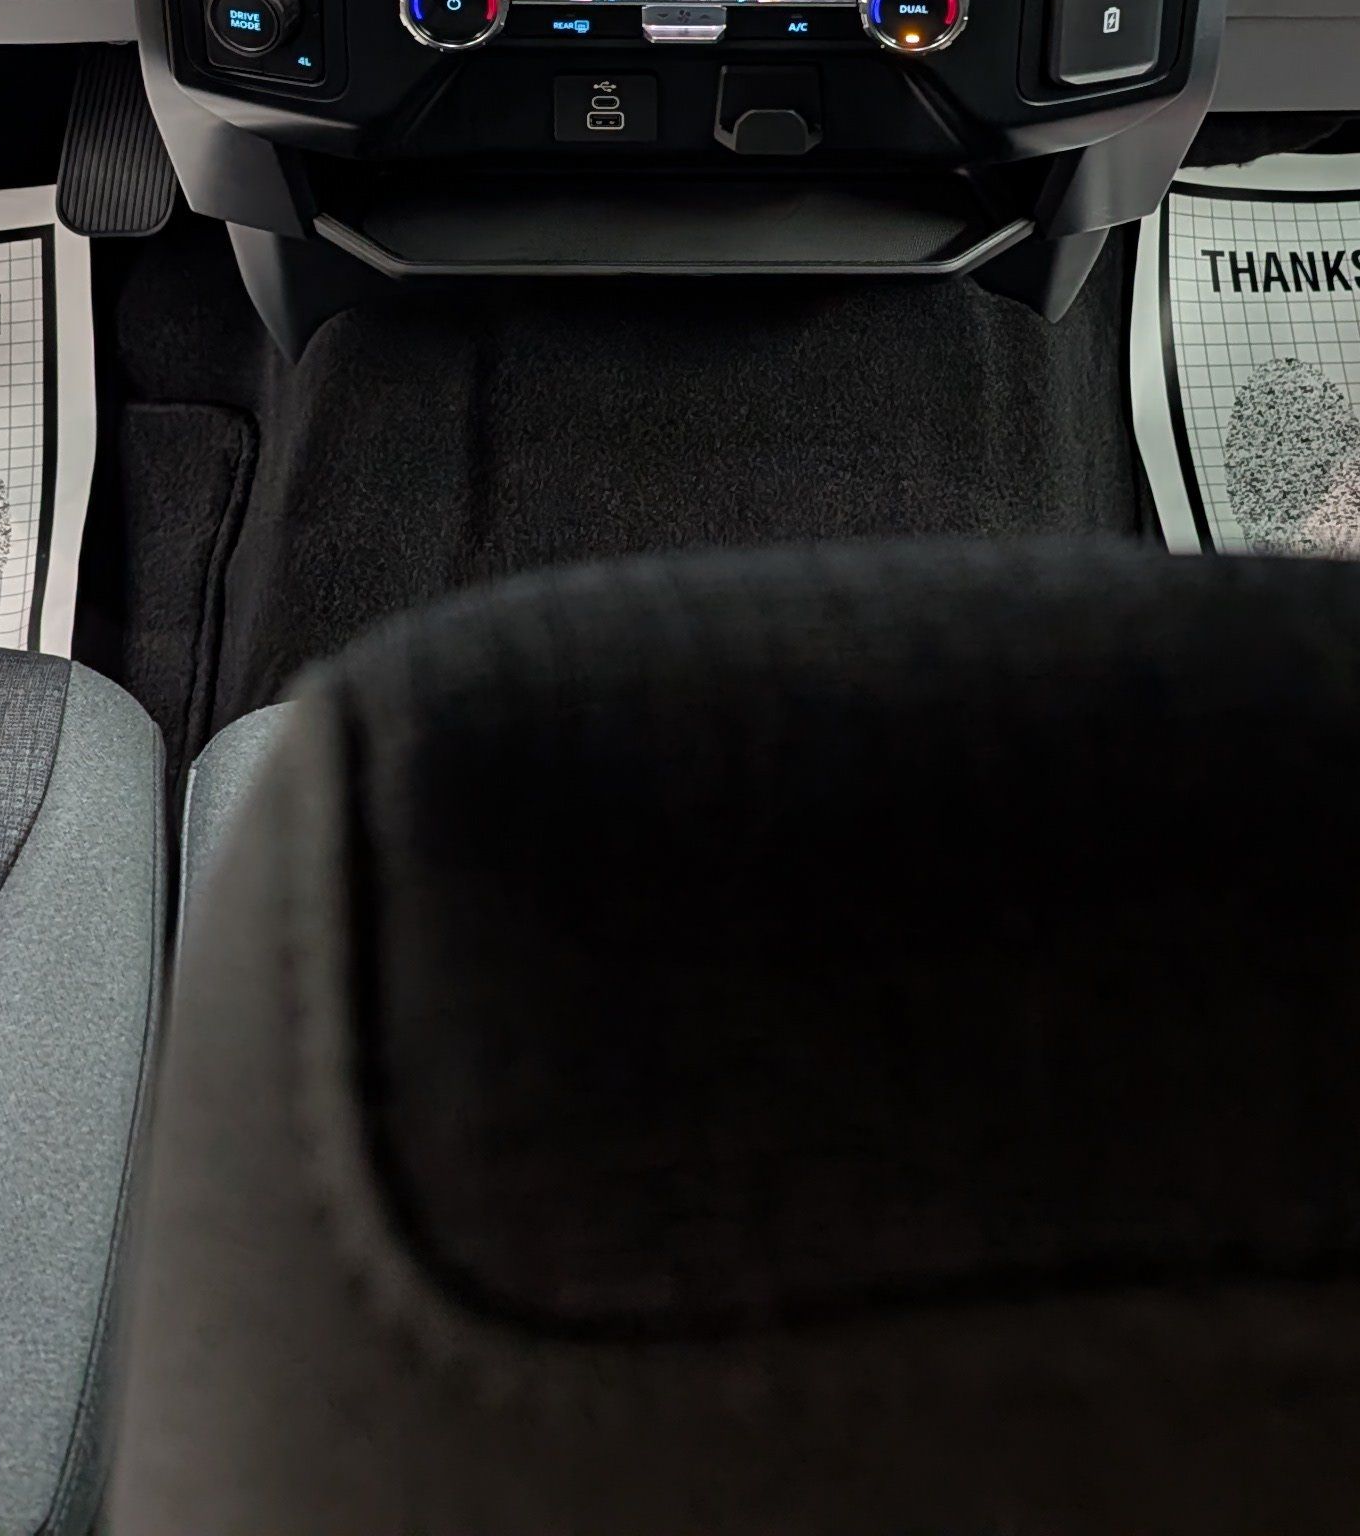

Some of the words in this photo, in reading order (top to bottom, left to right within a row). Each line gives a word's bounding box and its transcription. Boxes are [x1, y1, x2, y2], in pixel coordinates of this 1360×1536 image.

[899, 4, 929, 15] DUAL
[230, 9, 260, 23] DRIVE
[230, 19, 262, 32] MODE
[553, 21, 574, 31] REAR
[788, 22, 808, 33] A/C
[297, 56, 312, 67] 4L
